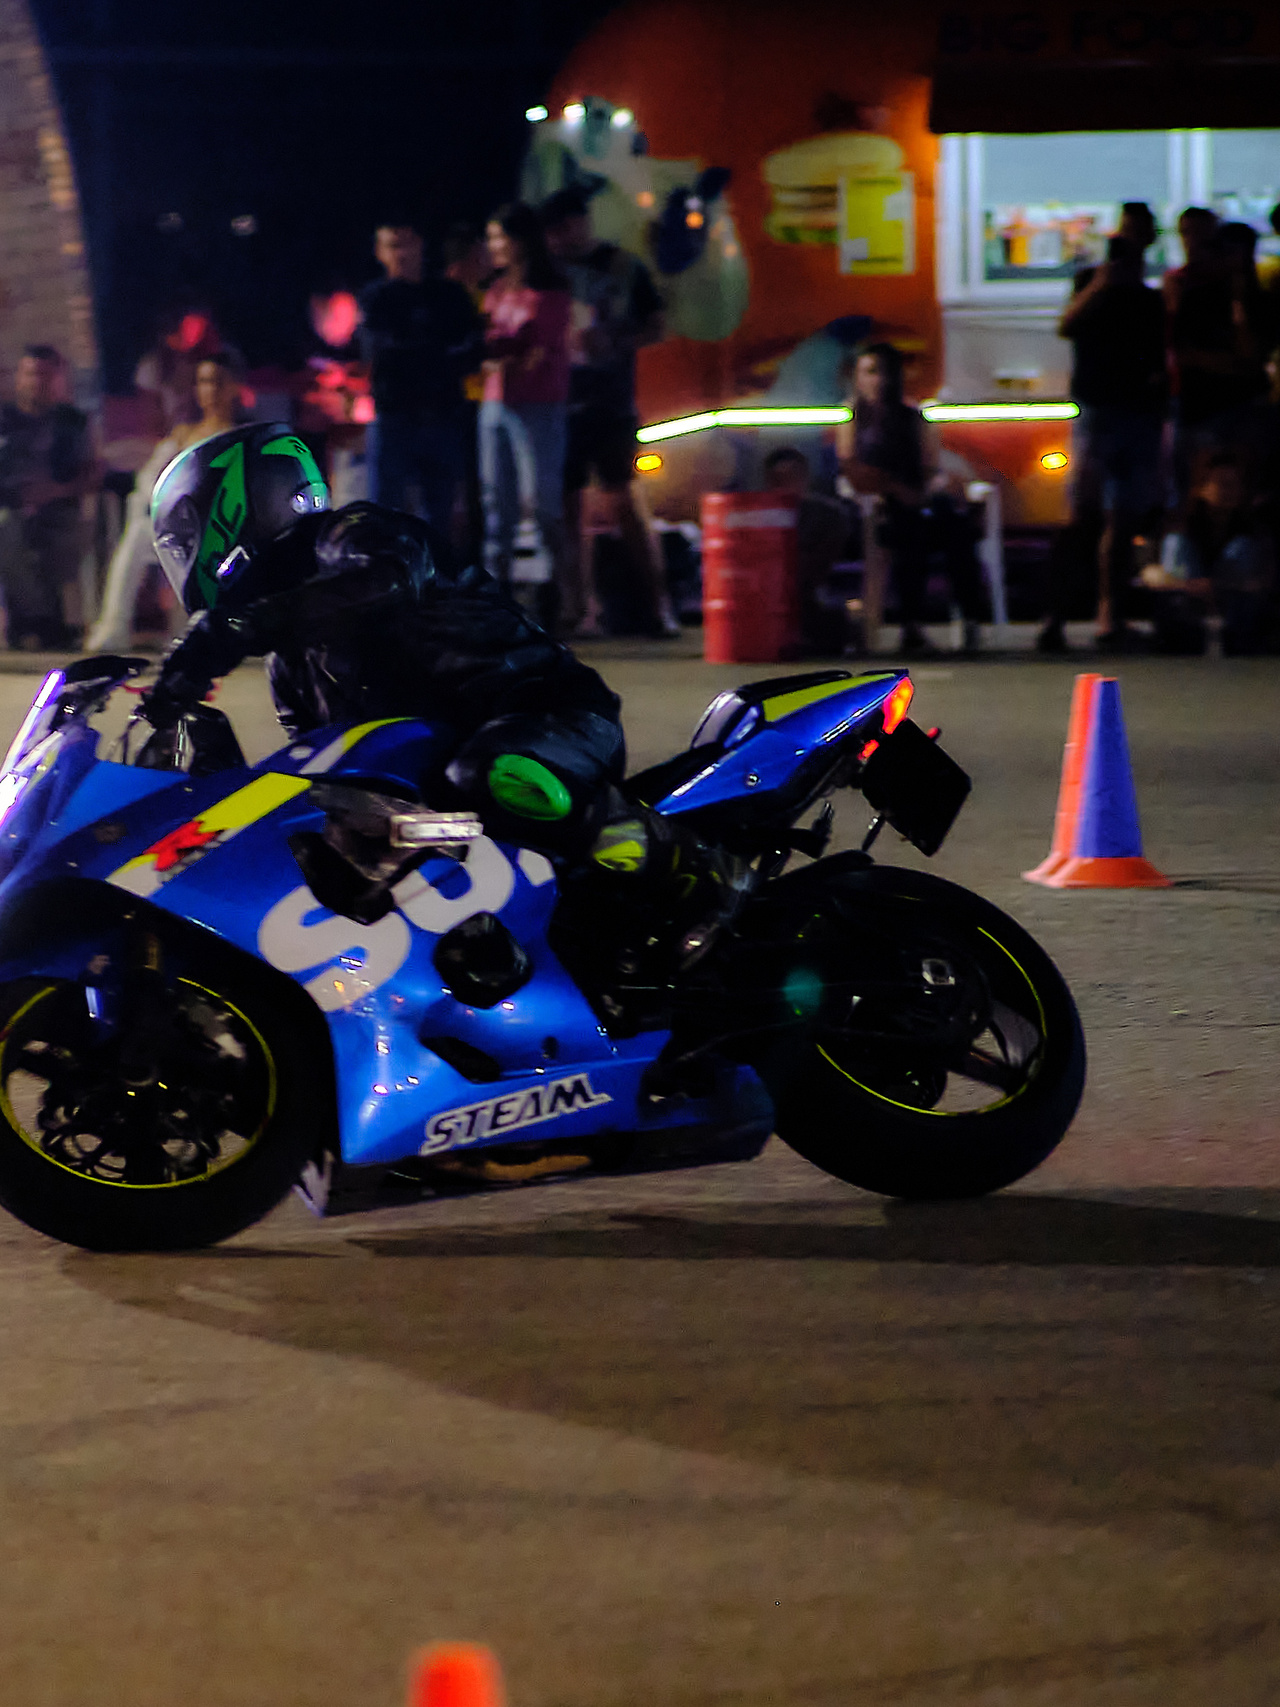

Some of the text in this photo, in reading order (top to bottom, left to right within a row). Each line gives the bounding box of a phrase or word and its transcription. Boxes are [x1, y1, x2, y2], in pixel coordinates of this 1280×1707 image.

[941, 8, 1255, 54] BIG FOOD
[423, 1076, 600, 1152] STEAM
